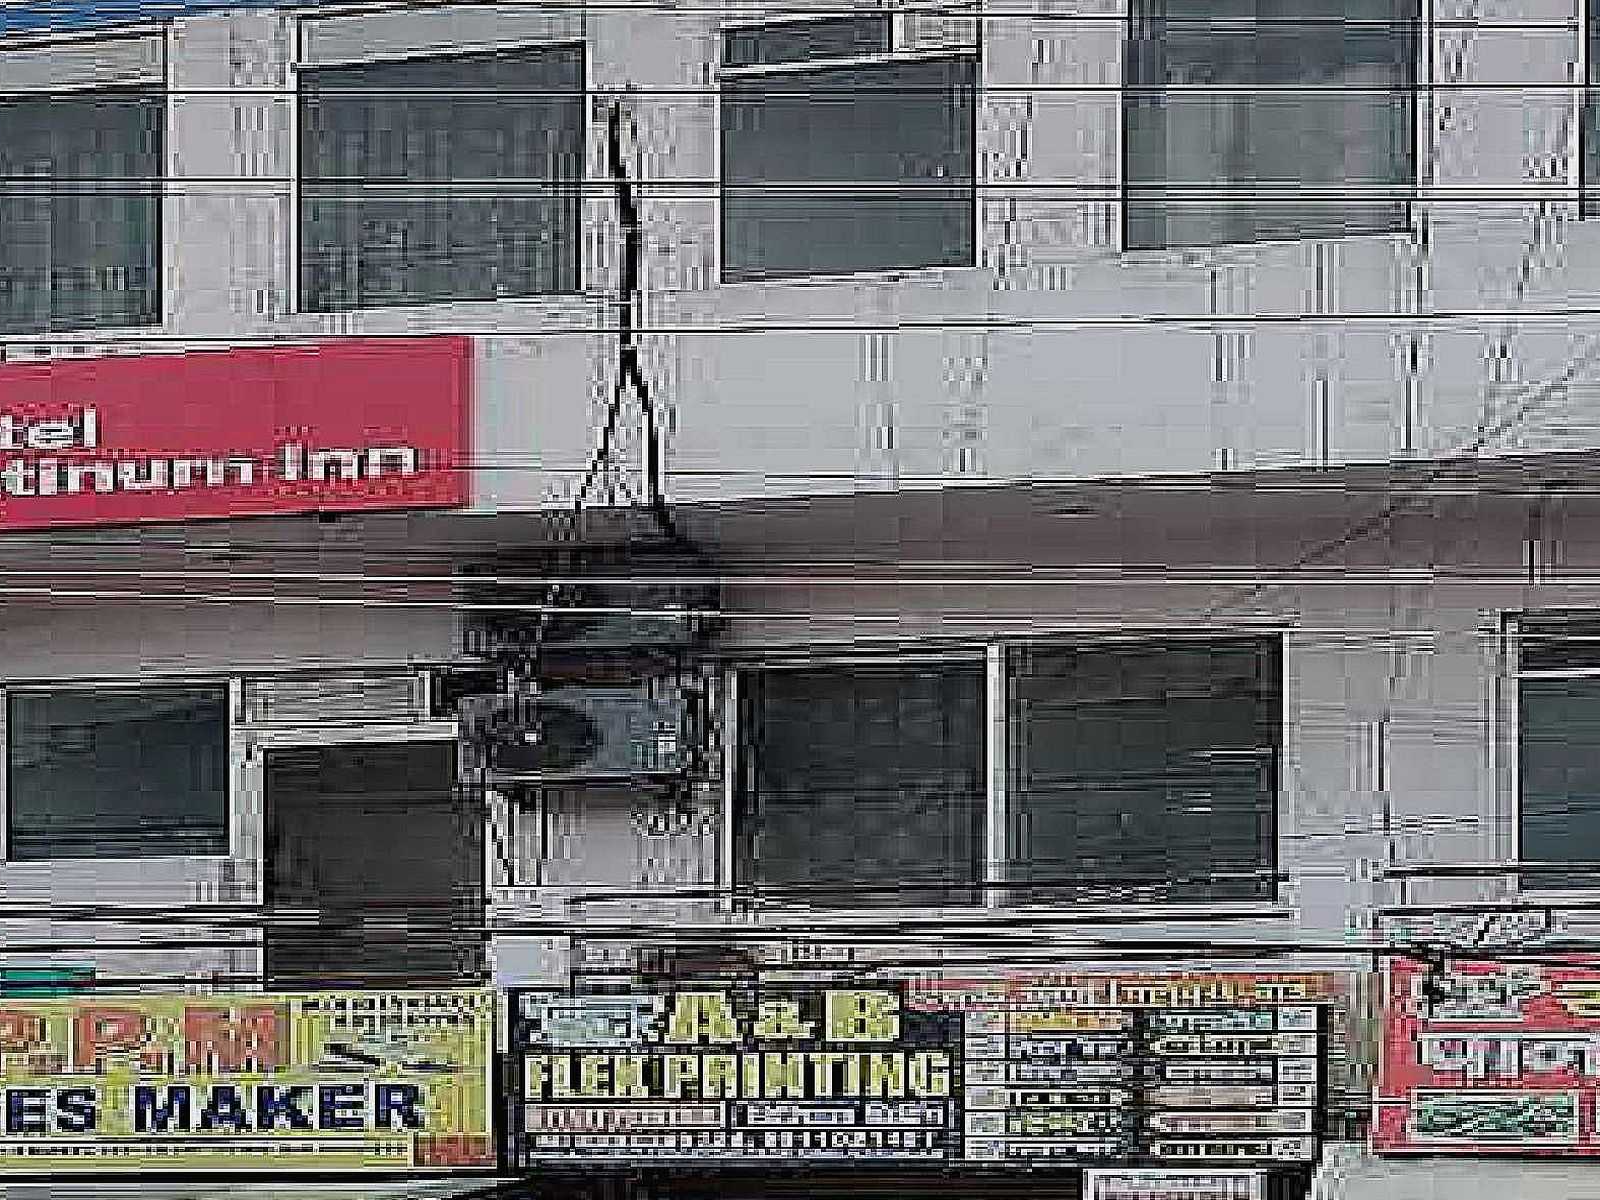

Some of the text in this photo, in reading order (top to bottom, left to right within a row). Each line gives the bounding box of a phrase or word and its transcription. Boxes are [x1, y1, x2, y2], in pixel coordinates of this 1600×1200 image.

[525, 1052, 950, 1099] FLEX PRINTING
[133, 1080, 428, 1133] MAKER
